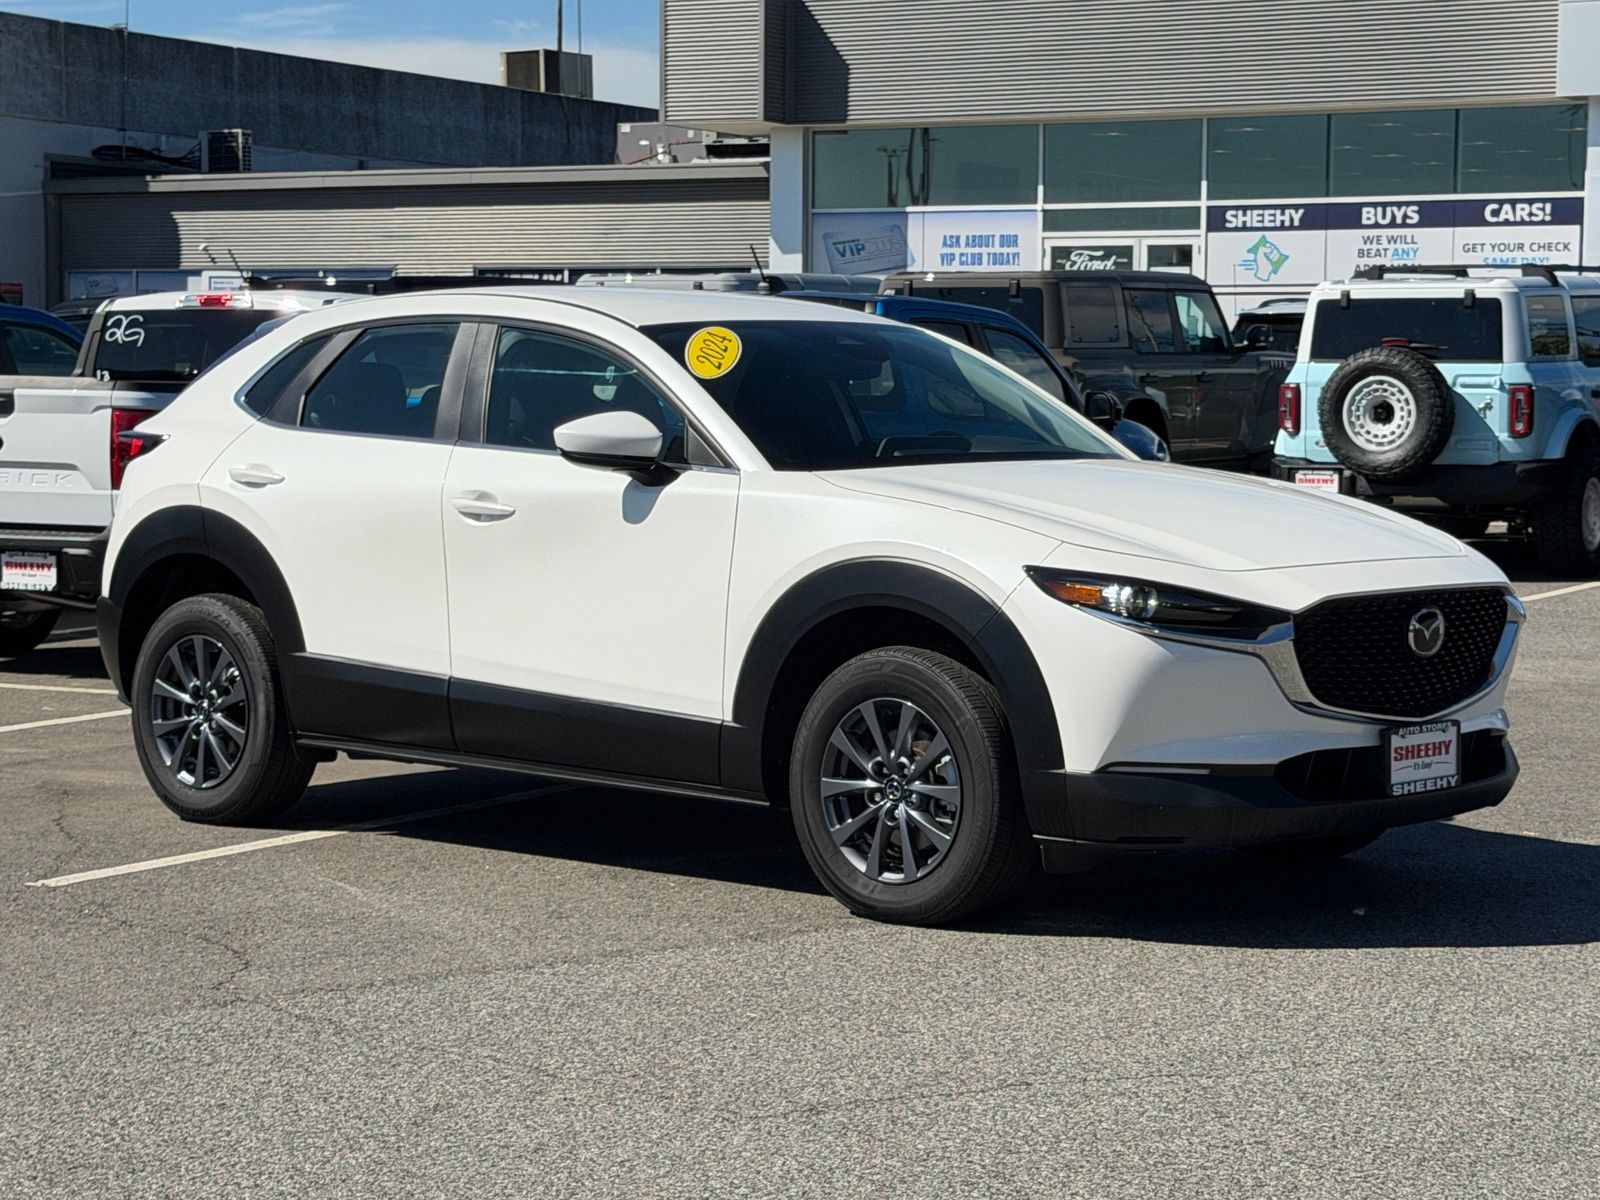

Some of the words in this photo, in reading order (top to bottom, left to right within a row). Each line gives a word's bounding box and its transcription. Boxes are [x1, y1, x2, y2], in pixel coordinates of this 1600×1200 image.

[1224, 208, 1304, 228] SHEEHY
[1361, 206, 1420, 225] BUYS
[1484, 203, 1552, 222] CARS!
[942, 235, 961, 248] ASK
[965, 234, 995, 248] ABOUT
[999, 234, 1018, 248] OUR
[1362, 235, 1383, 245] WE
[1386, 234, 1418, 245] WILL
[833, 243, 866, 258] VIP
[1357, 248, 1389, 258] BEAT
[1391, 247, 1419, 259] ANY
[1462, 243, 1486, 253] GET
[1489, 242, 1525, 252] YOUR
[1529, 242, 1572, 252] CHECK
[940, 252, 956, 266] VIP
[959, 252, 983, 266] CLUB
[986, 252, 1020, 266] TODAY!
[1064, 250, 1117, 270] Ford
[696, 331, 732, 370] 2024
[1398, 726, 1420, 737] AUTO
[1393, 739, 1453, 762] SHEEHY
[1392, 776, 1458, 796] SHEEHY
